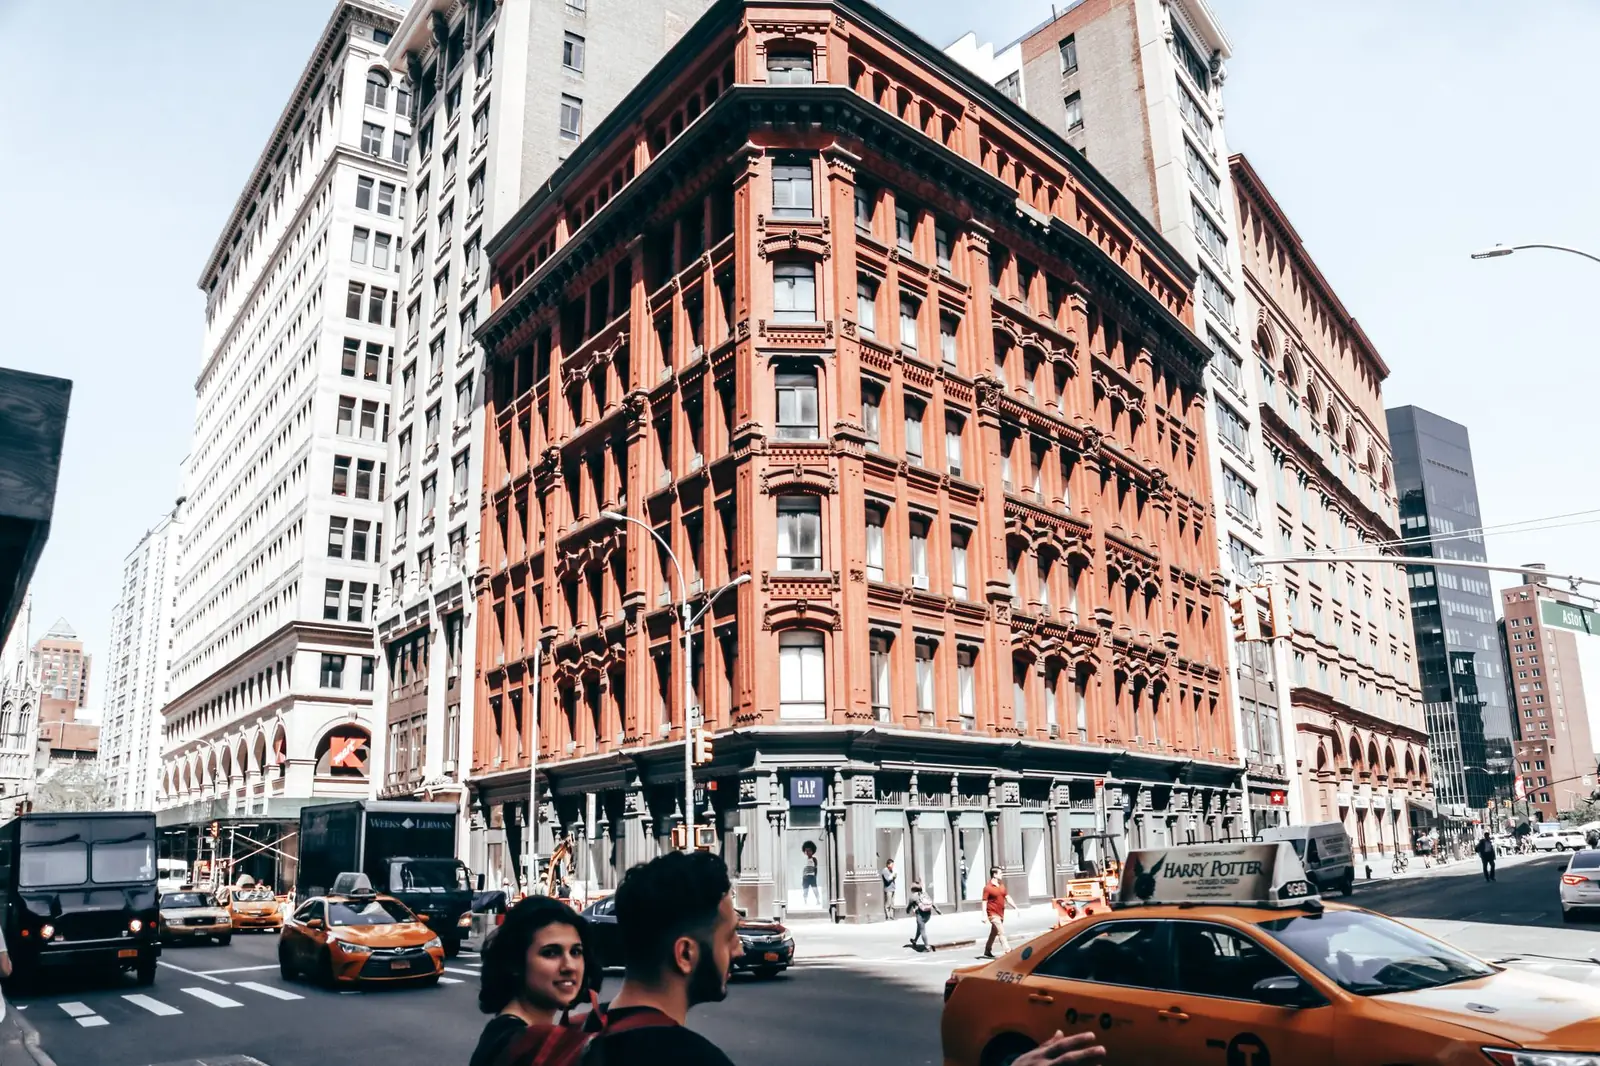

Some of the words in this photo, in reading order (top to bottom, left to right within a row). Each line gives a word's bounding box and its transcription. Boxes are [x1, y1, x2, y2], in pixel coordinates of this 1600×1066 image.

[1562, 609, 1582, 627] Astor
[797, 780, 816, 794] GAP
[1163, 861, 1210, 878] HARRY
[1210, 860, 1264, 877] POTTER
